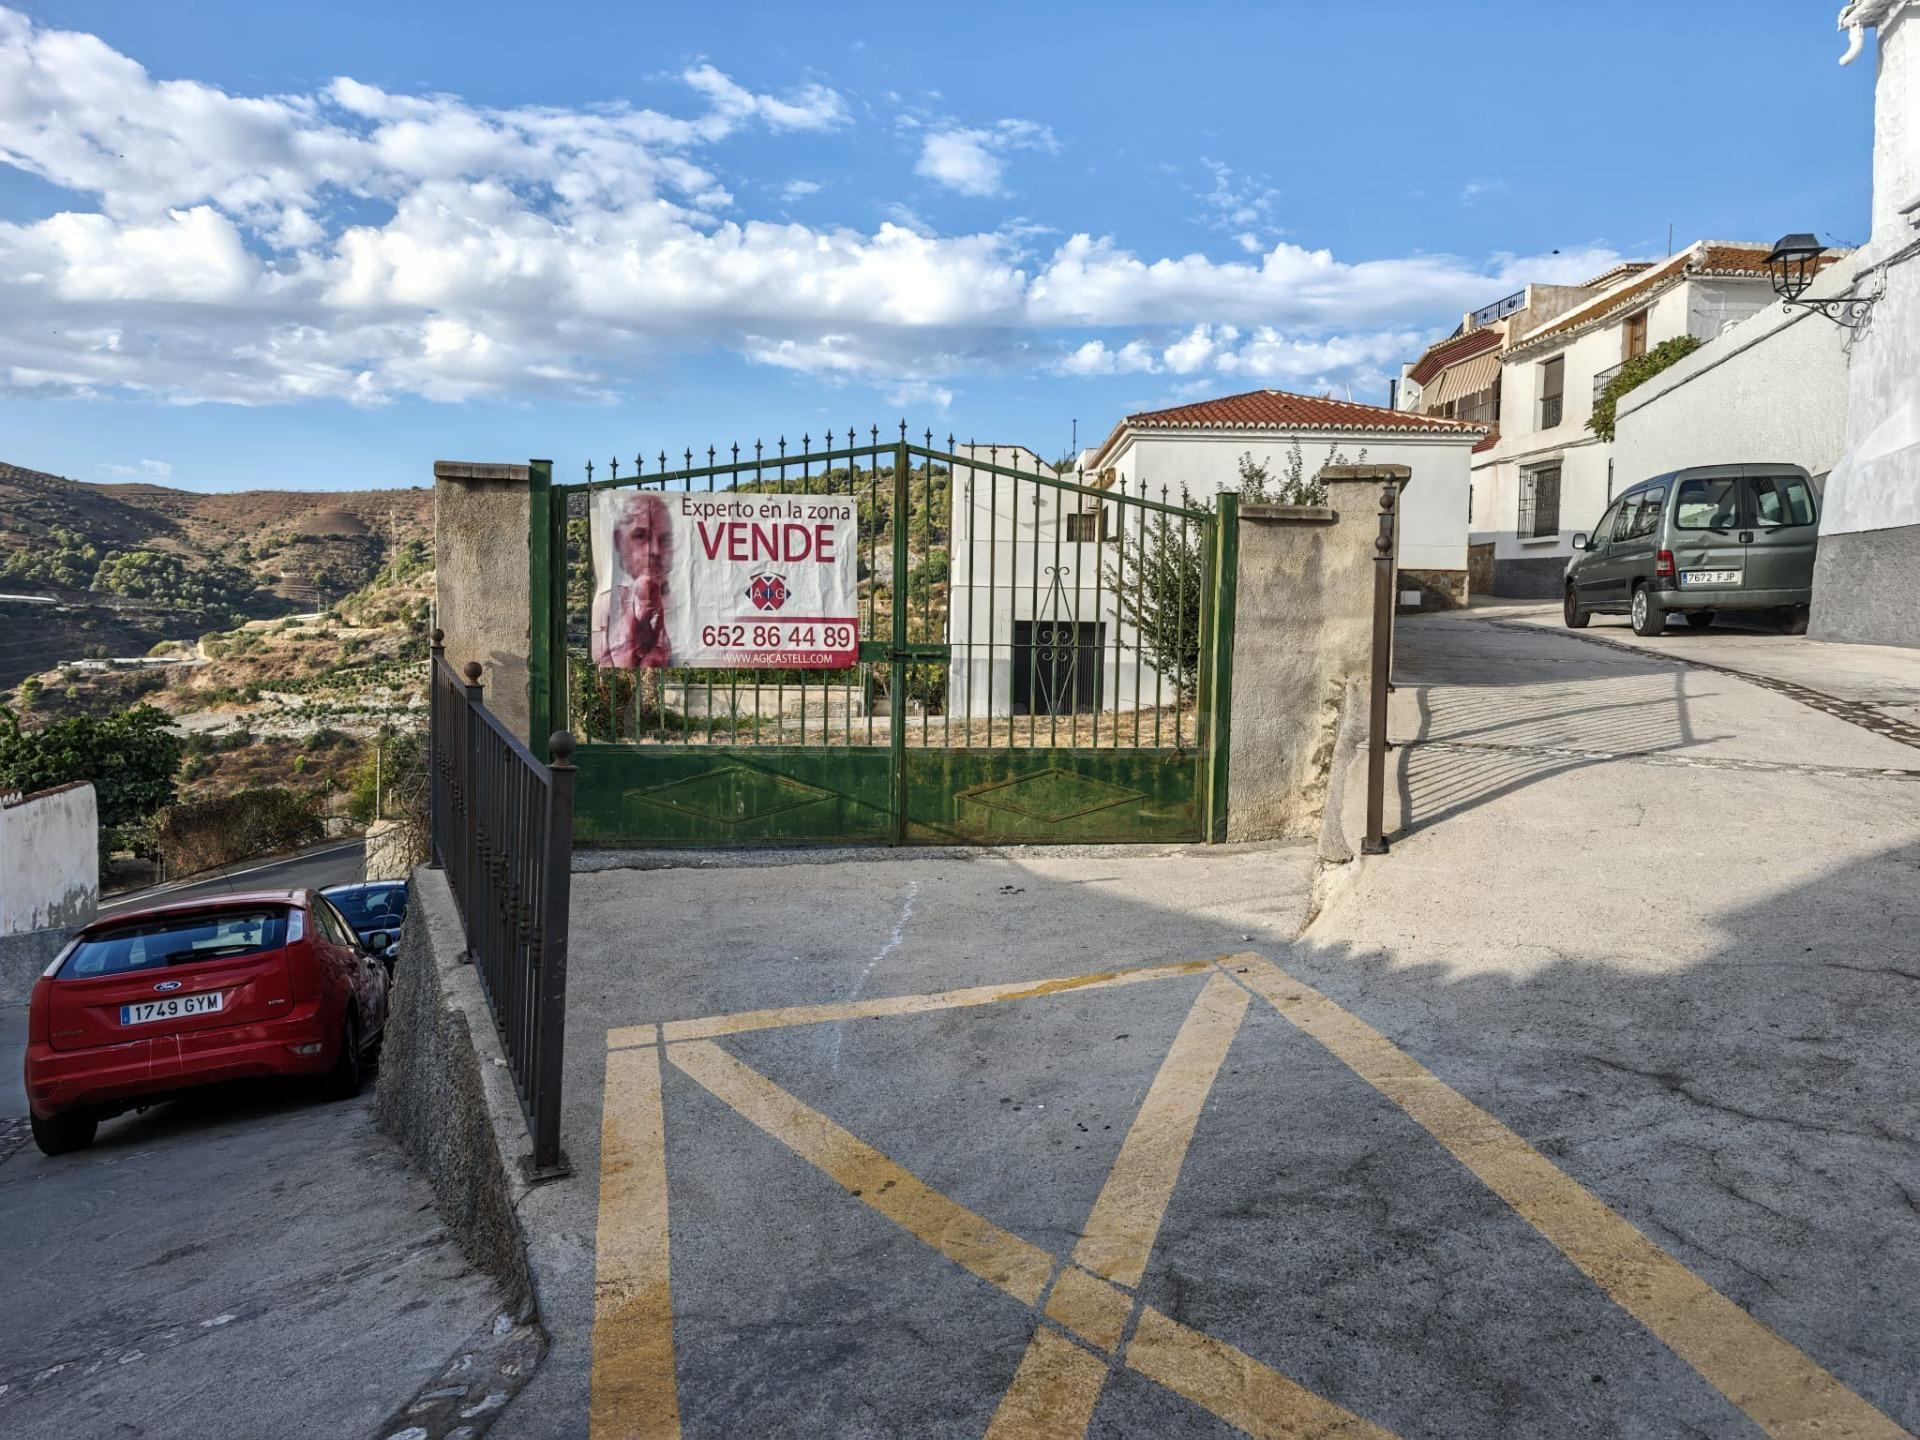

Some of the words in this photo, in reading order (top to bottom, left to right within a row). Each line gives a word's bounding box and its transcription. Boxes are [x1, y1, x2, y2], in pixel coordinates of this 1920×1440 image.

[682, 498, 754, 521] Experto
[759, 503, 782, 519] en
[787, 500, 802, 519] la
[807, 503, 851, 520] zona
[697, 521, 836, 563] VENDE
[1689, 573, 1712, 582] 7672
[1717, 572, 1735, 581] FJP
[702, 626, 745, 647] 652
[753, 626, 781, 647] 86
[788, 626, 816, 647] 44
[823, 626, 851, 648] 89
[721, 653, 833, 665] WWW.AGICASTELL.COM
[135, 1001, 179, 1021] 1749
[184, 995, 219, 1013] GYM
